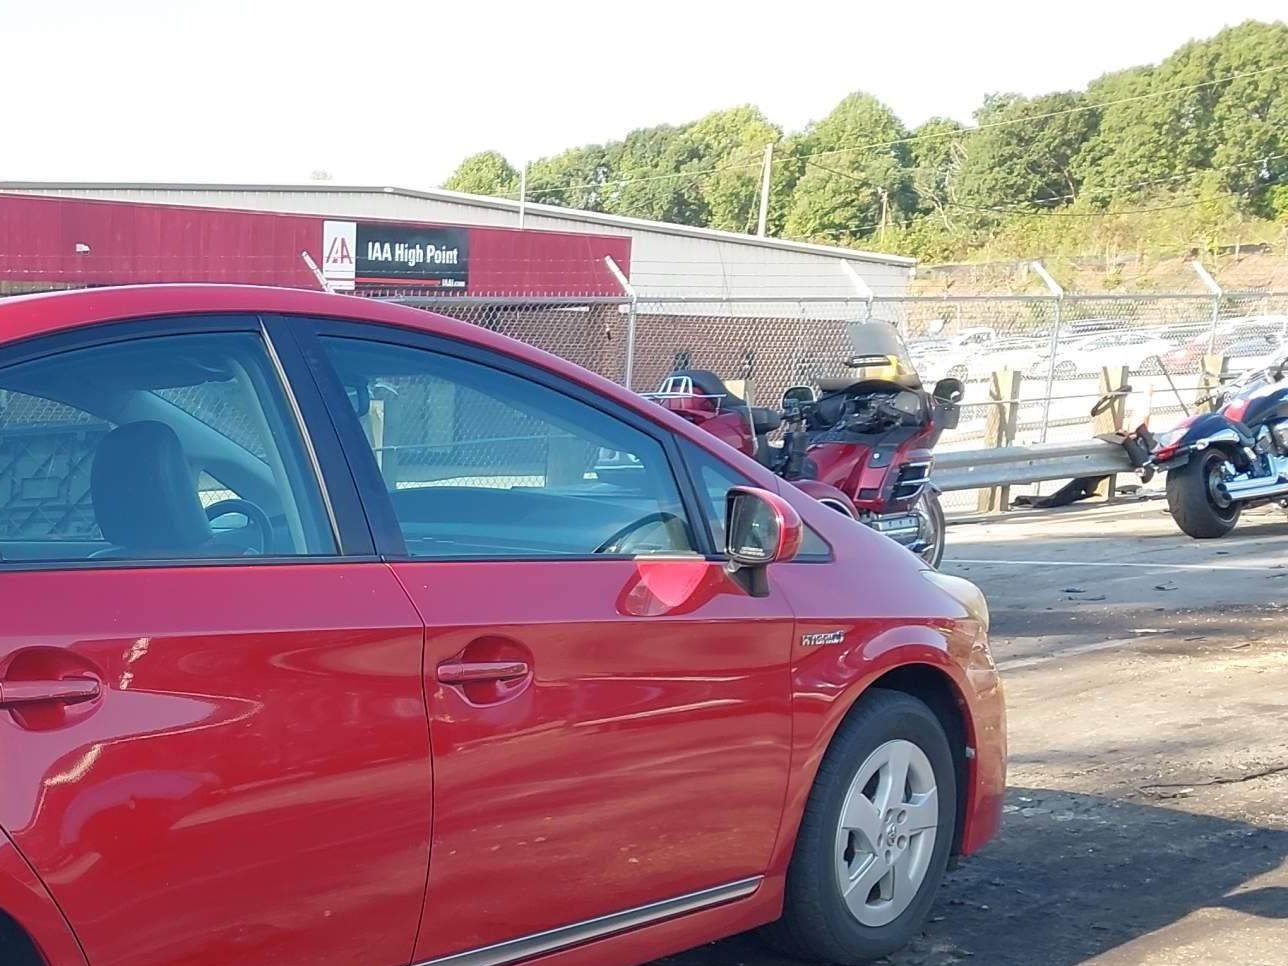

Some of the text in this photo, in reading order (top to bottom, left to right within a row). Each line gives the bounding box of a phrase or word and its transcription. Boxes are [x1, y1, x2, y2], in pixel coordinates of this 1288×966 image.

[367, 241, 458, 267] IAA High Point
